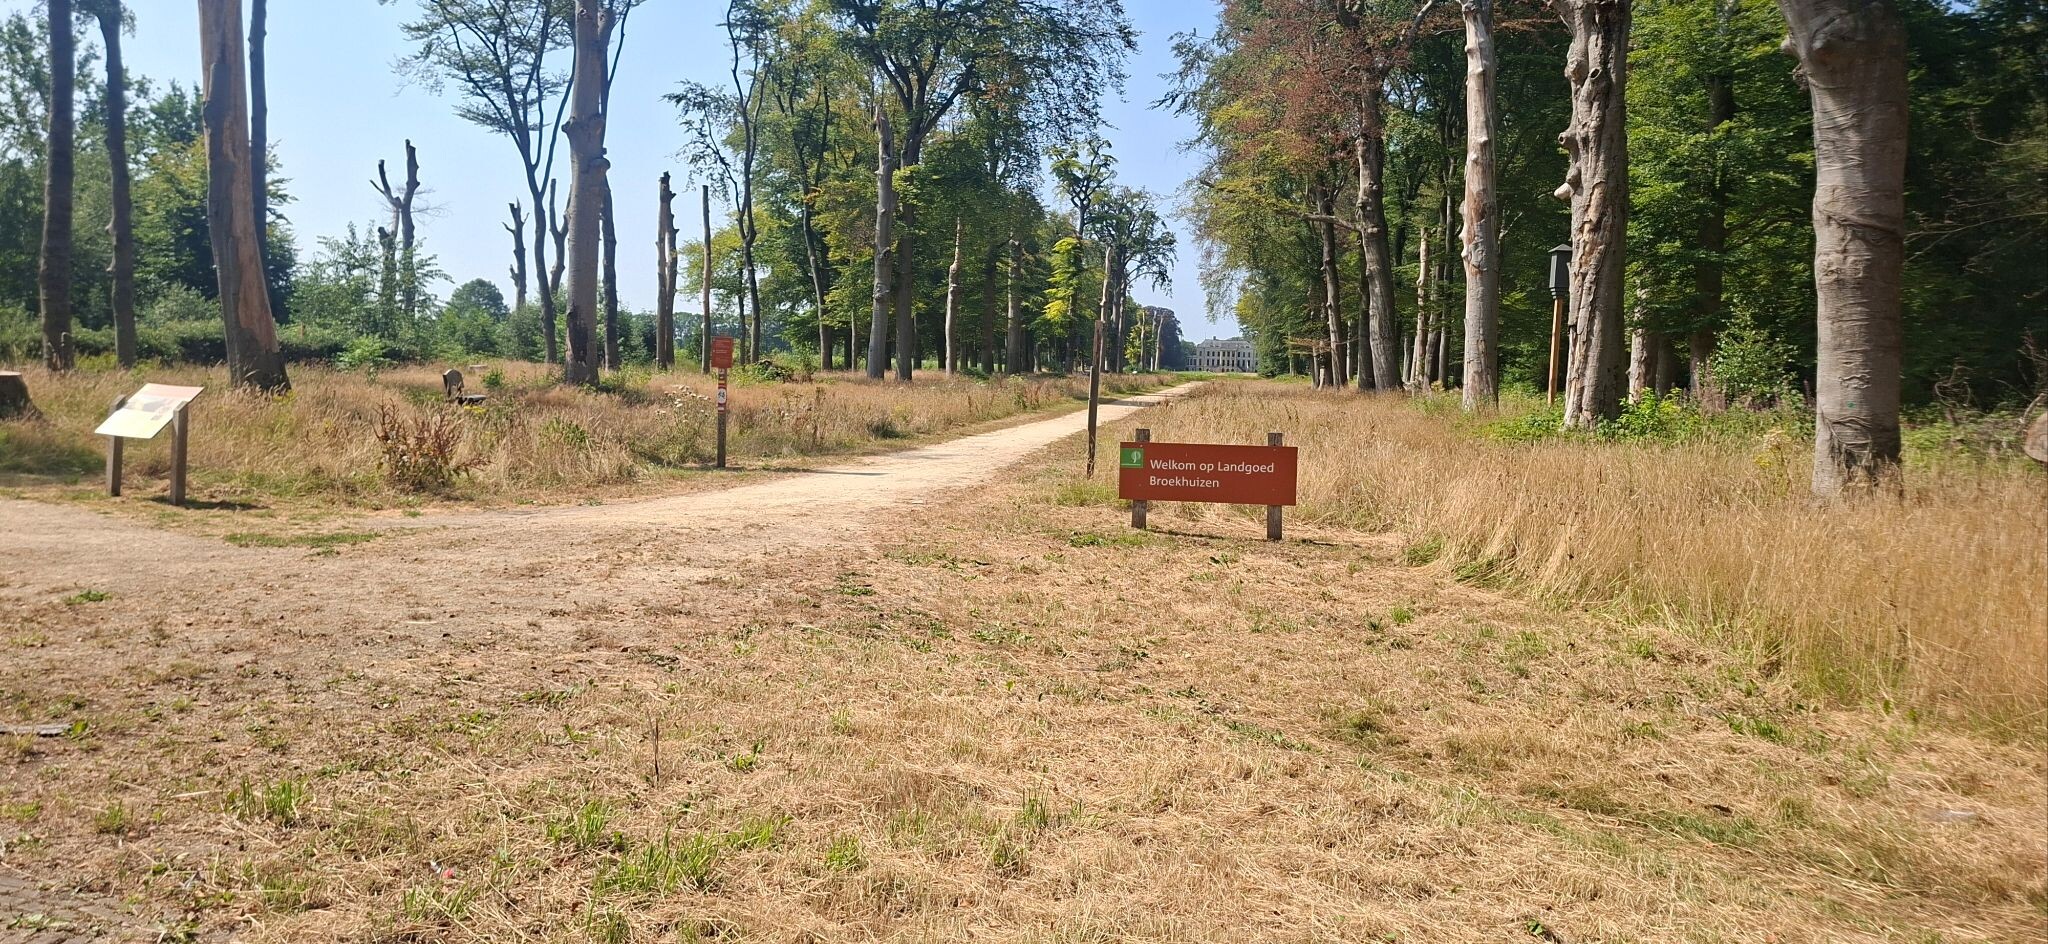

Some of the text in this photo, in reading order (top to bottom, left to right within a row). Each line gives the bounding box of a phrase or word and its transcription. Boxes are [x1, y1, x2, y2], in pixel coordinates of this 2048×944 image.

[1150, 459, 1275, 475] Welkom op Landgoed
[1149, 475, 1220, 488] Broekhuizen
